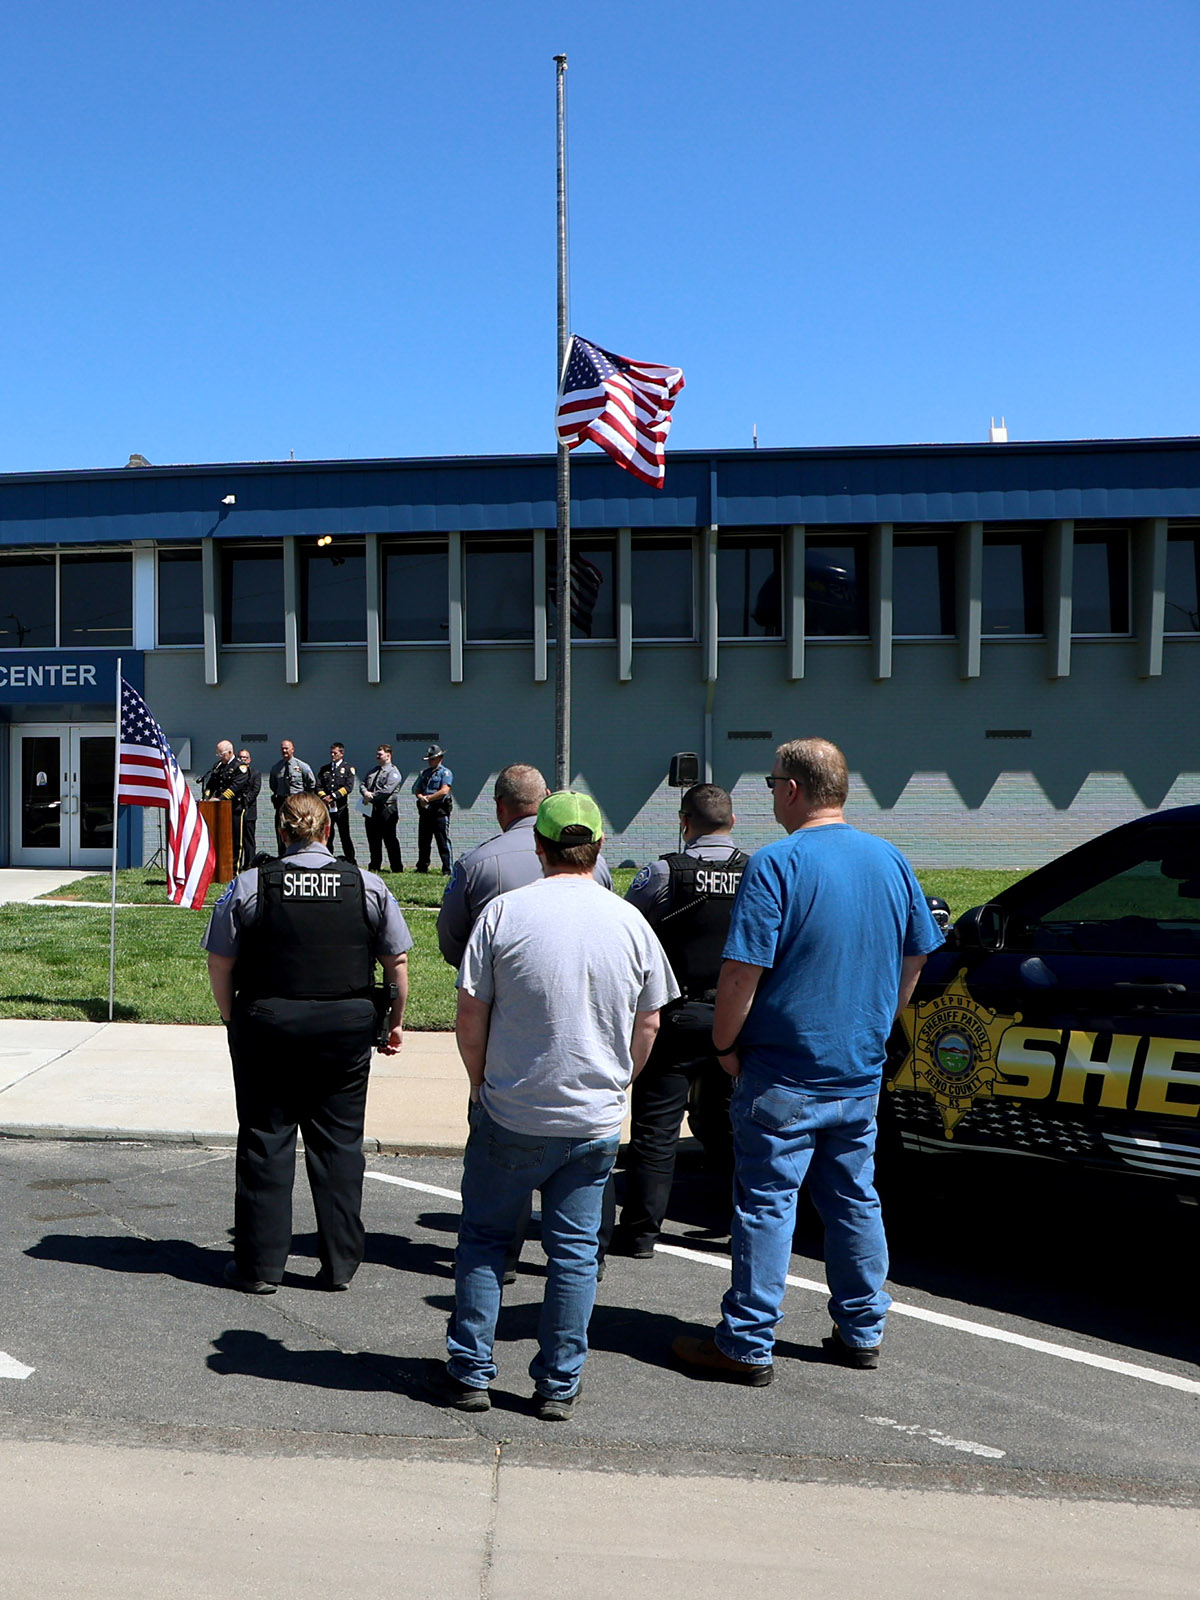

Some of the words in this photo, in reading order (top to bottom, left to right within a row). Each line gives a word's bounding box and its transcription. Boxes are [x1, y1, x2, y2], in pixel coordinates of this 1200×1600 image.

[283, 873, 341, 897] SHERIFF
[695, 870, 743, 894] SHERIF
[932, 997, 980, 1012] DEPUTY
[921, 1011, 959, 1038] SHERIFF
[961, 1014, 988, 1048] PATROL
[924, 1069, 947, 1092] RENO
[948, 1075, 982, 1096] COUNTY
[992, 1025, 1200, 1118] SHE
[949, 1098, 960, 1108] KS
